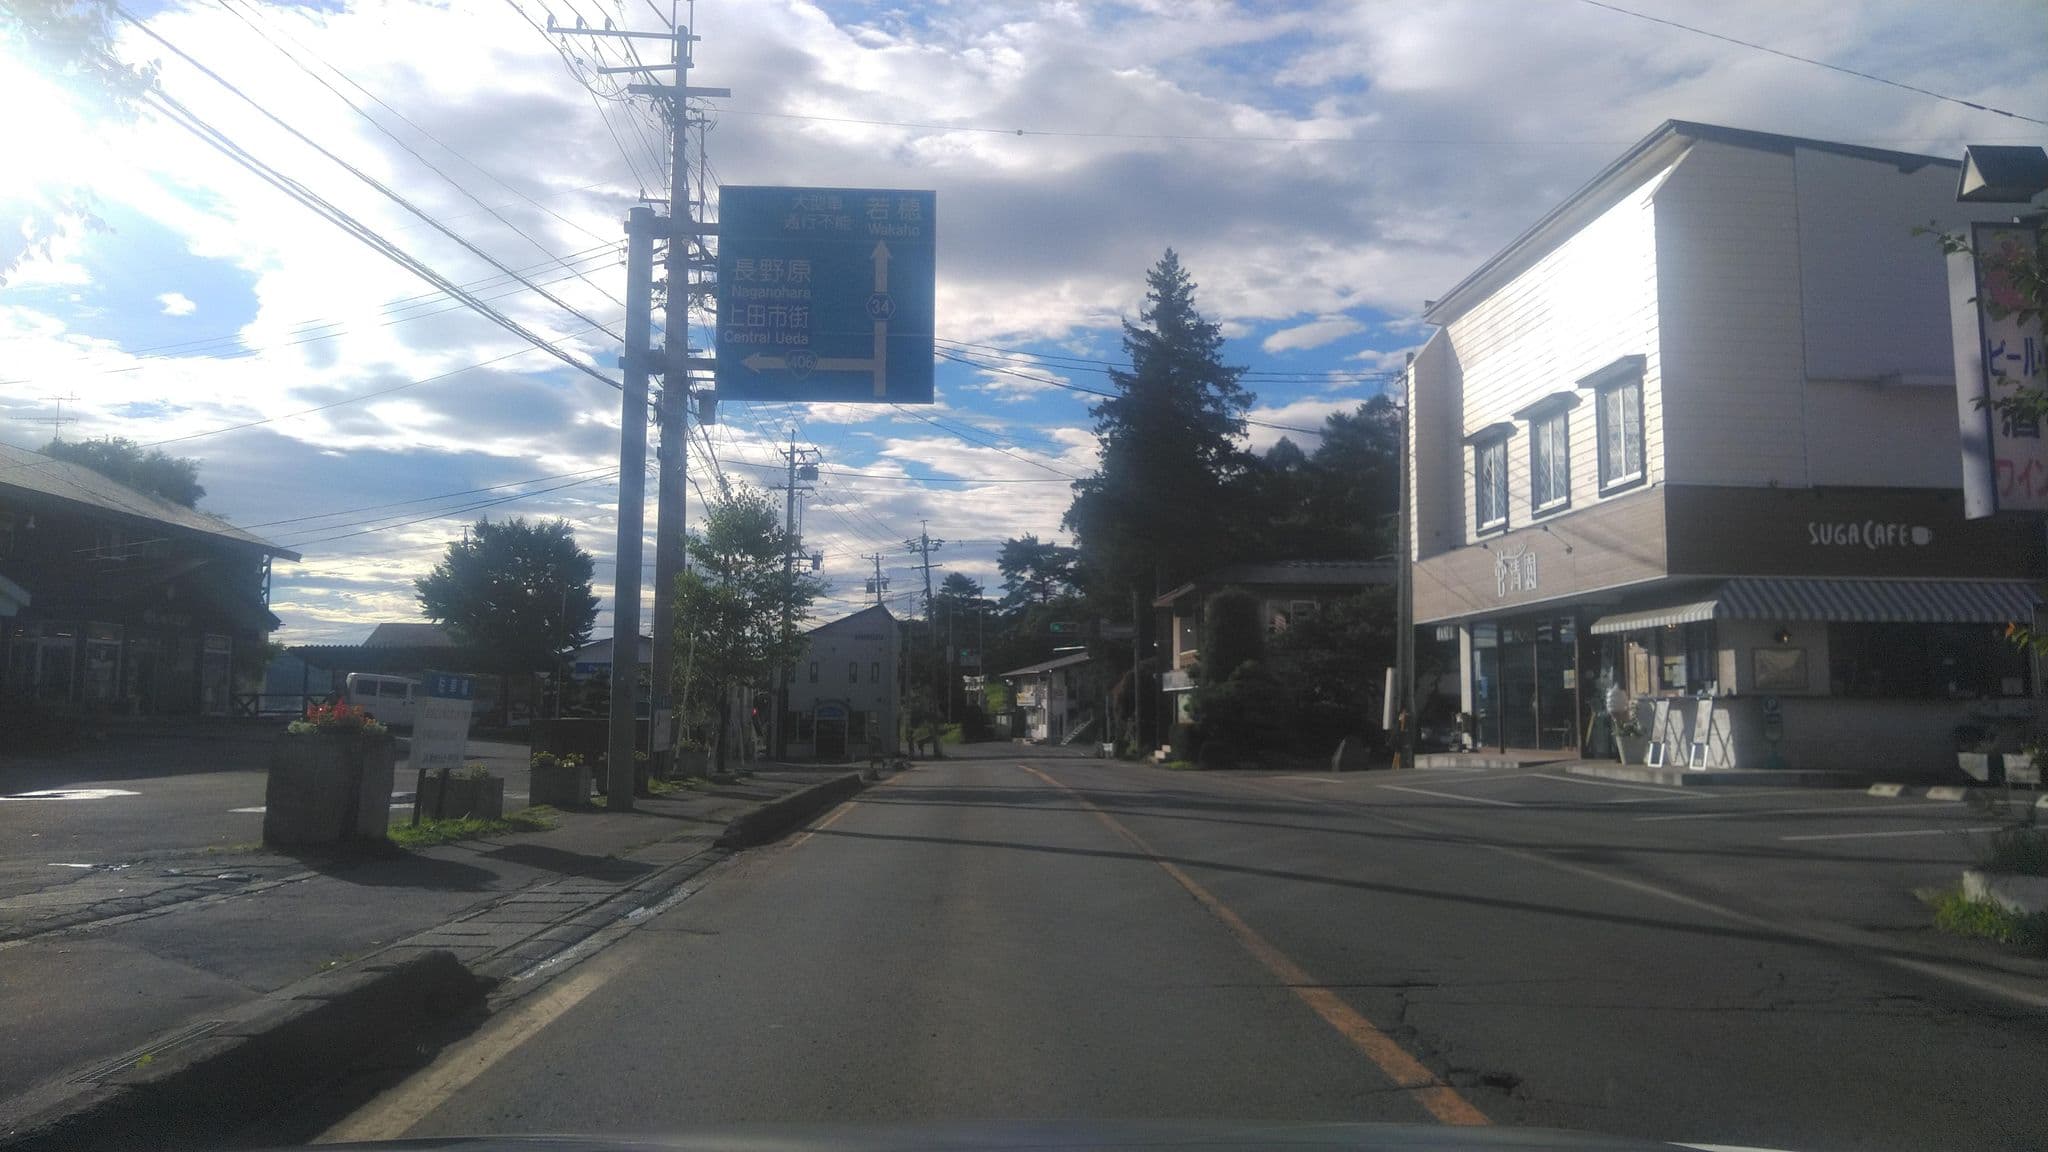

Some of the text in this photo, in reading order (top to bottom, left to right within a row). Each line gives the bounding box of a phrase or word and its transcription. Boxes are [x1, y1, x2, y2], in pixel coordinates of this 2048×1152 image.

[866, 223, 921, 236] Wakaho
[734, 257, 812, 283] 長野原
[731, 285, 812, 300] Naganohara
[871, 299, 890, 315] 34
[726, 304, 809, 329] 上田市街
[723, 330, 809, 345] Central Ueda
[788, 355, 813, 369] 406
